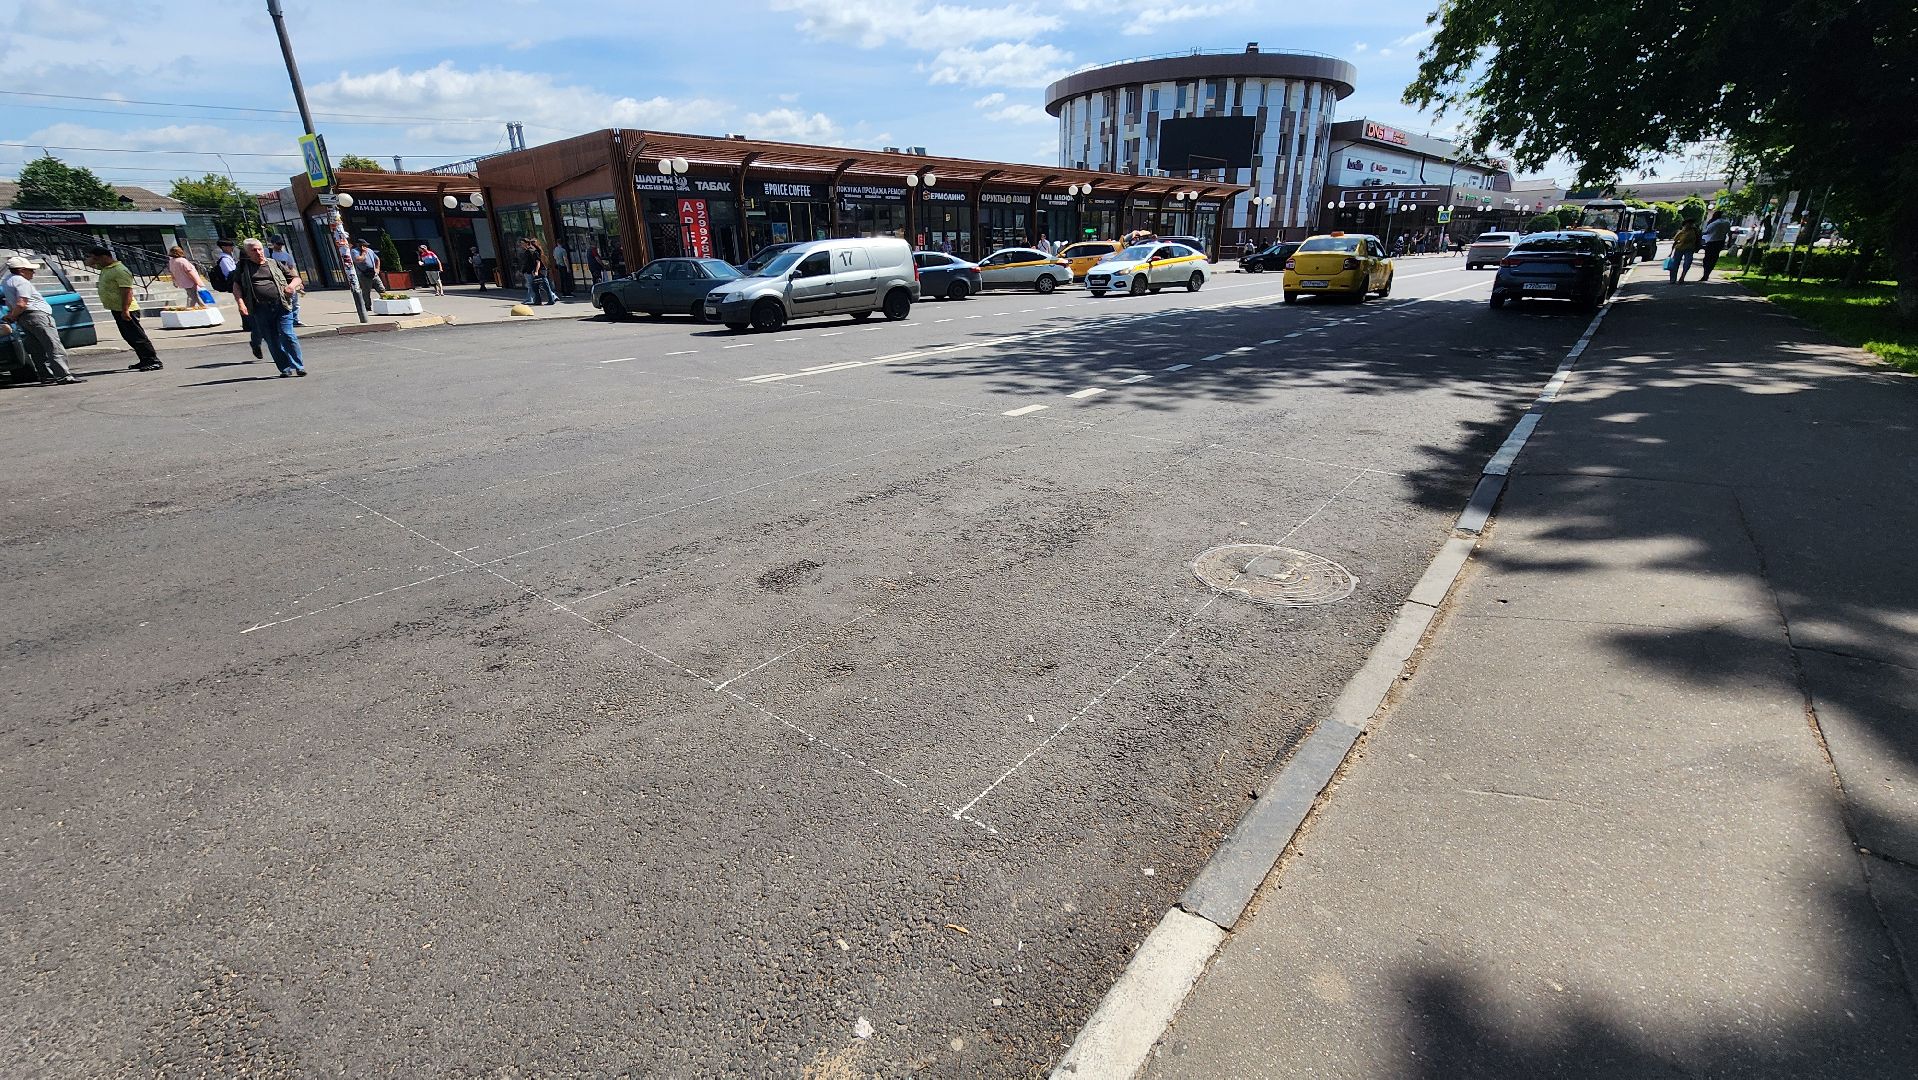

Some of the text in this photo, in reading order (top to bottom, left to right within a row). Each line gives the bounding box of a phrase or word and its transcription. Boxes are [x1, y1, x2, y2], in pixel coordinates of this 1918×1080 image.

[1368, 123, 1384, 140] DNS
[694, 181, 731, 192] ТАБАК
[769, 183, 811, 197] PRICE COFFEE
[836, 185, 861, 194] ПОКУПКА
[861, 187, 887, 196] ПРОДАЖА
[887, 187, 907, 196] РЕМОНТ
[358, 199, 422, 207] ШАШЛЫЧНАЯ
[981, 193, 1006, 203] ФРУКТЫ
[839, 251, 853, 266] 17
